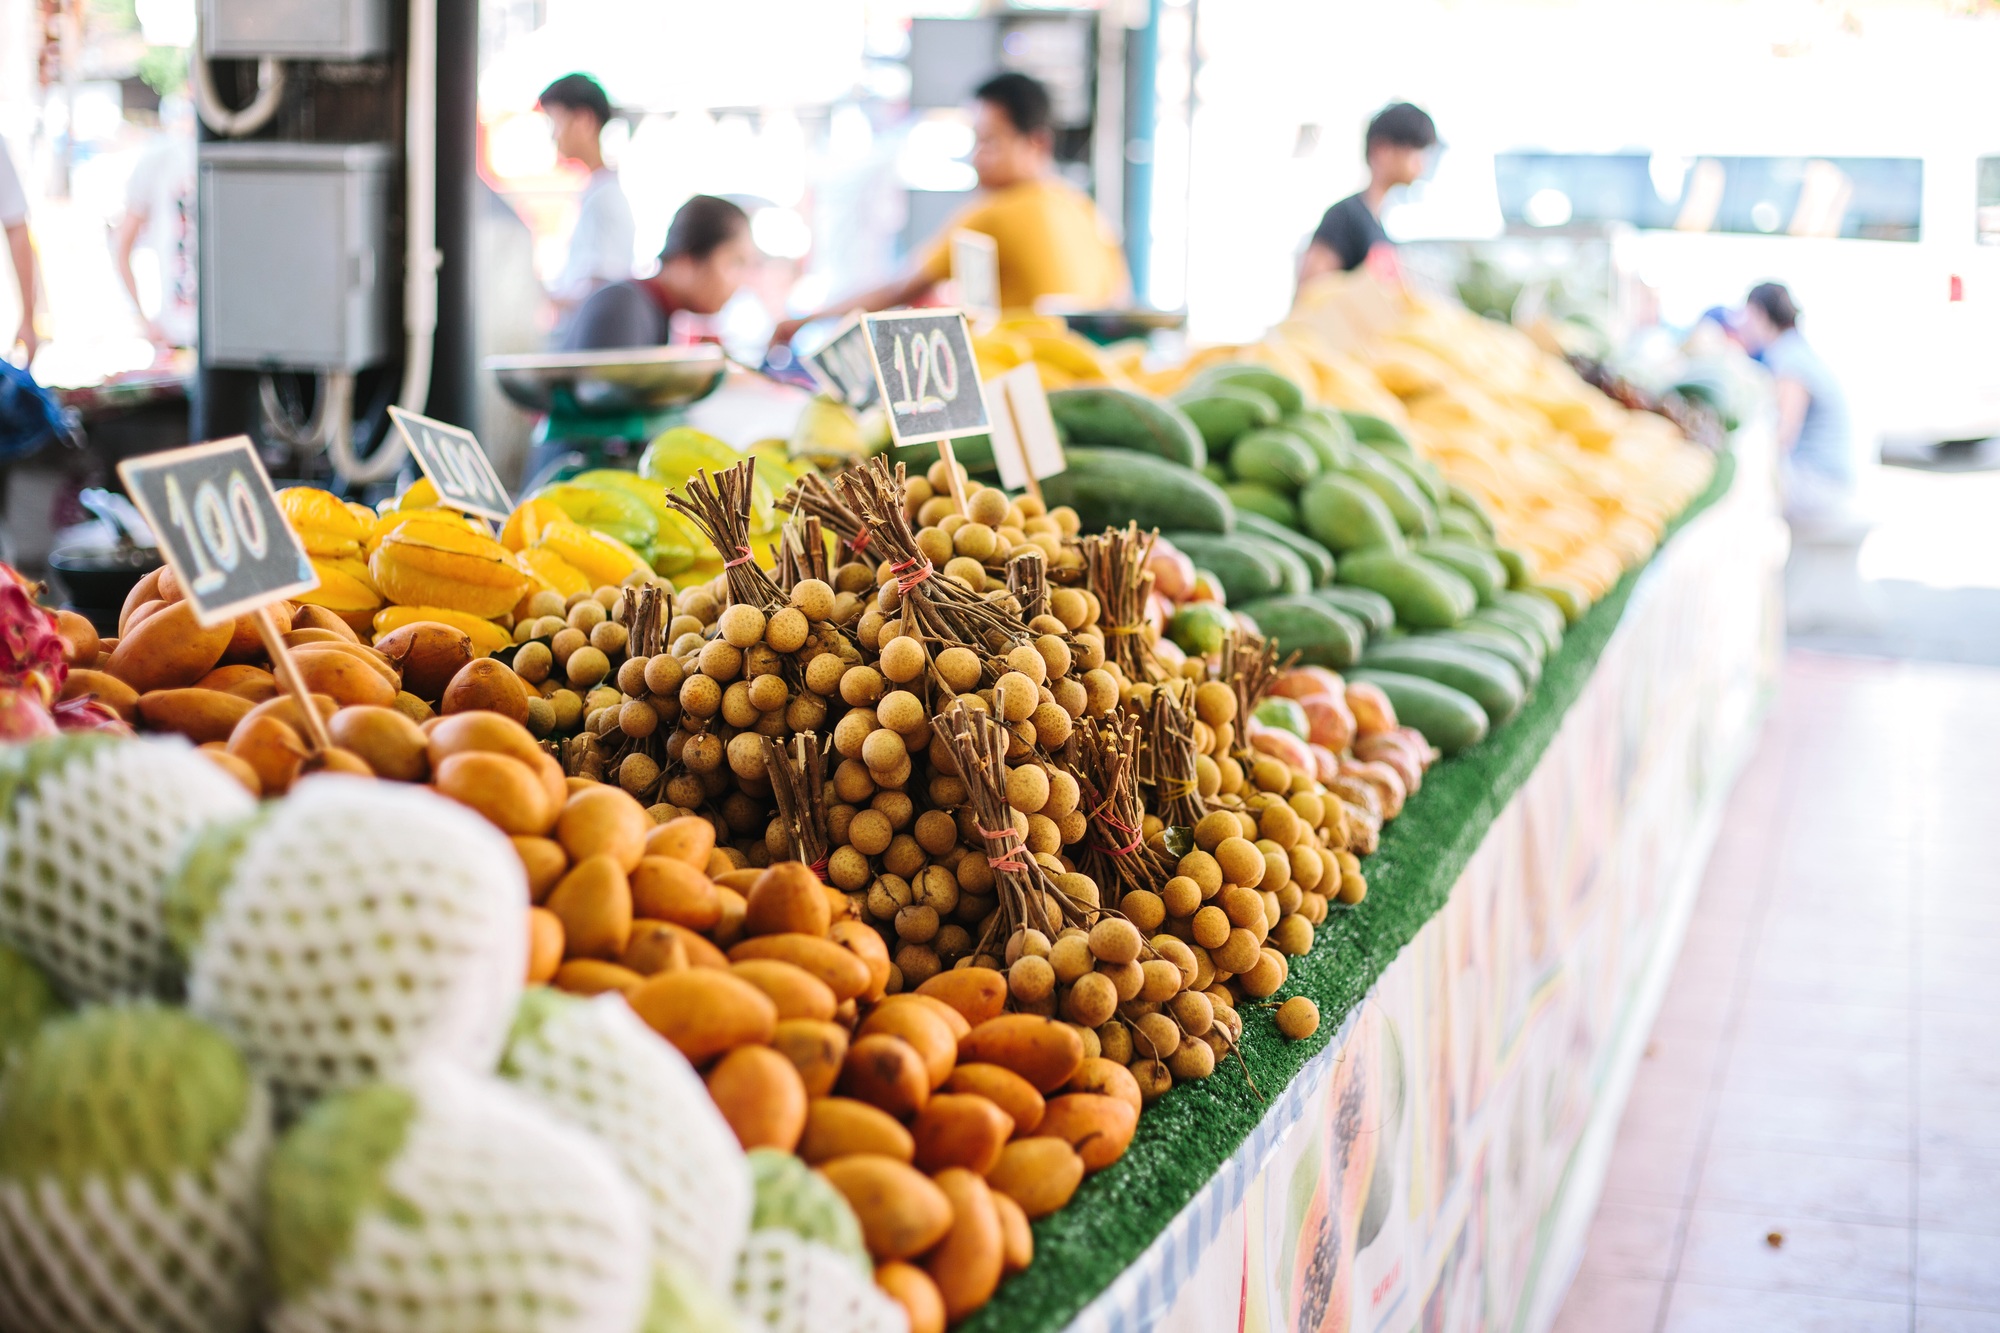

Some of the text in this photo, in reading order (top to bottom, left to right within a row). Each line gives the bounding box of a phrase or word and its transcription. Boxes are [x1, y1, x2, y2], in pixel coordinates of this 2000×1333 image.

[893, 328, 959, 416] 120
[421, 428, 496, 504] 100
[164, 470, 268, 595] 100
